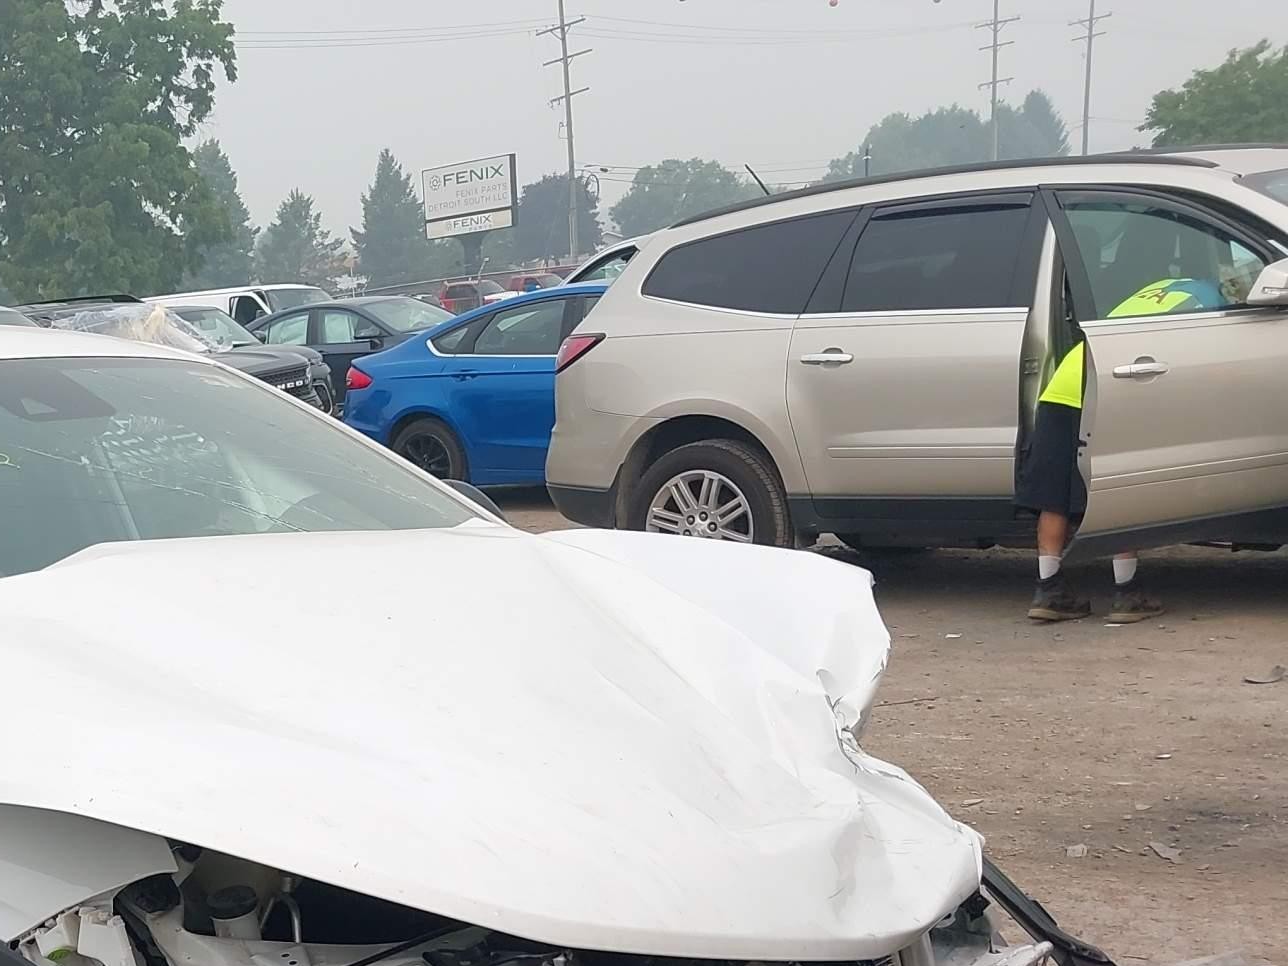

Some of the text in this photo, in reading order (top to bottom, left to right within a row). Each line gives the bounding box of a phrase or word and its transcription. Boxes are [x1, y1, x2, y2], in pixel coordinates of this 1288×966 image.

[443, 164, 504, 187] FENIX
[455, 183, 507, 199] FENIX PARTS
[428, 191, 508, 212] DETROIT SOUTH LLC
[453, 215, 491, 229] FENIX
